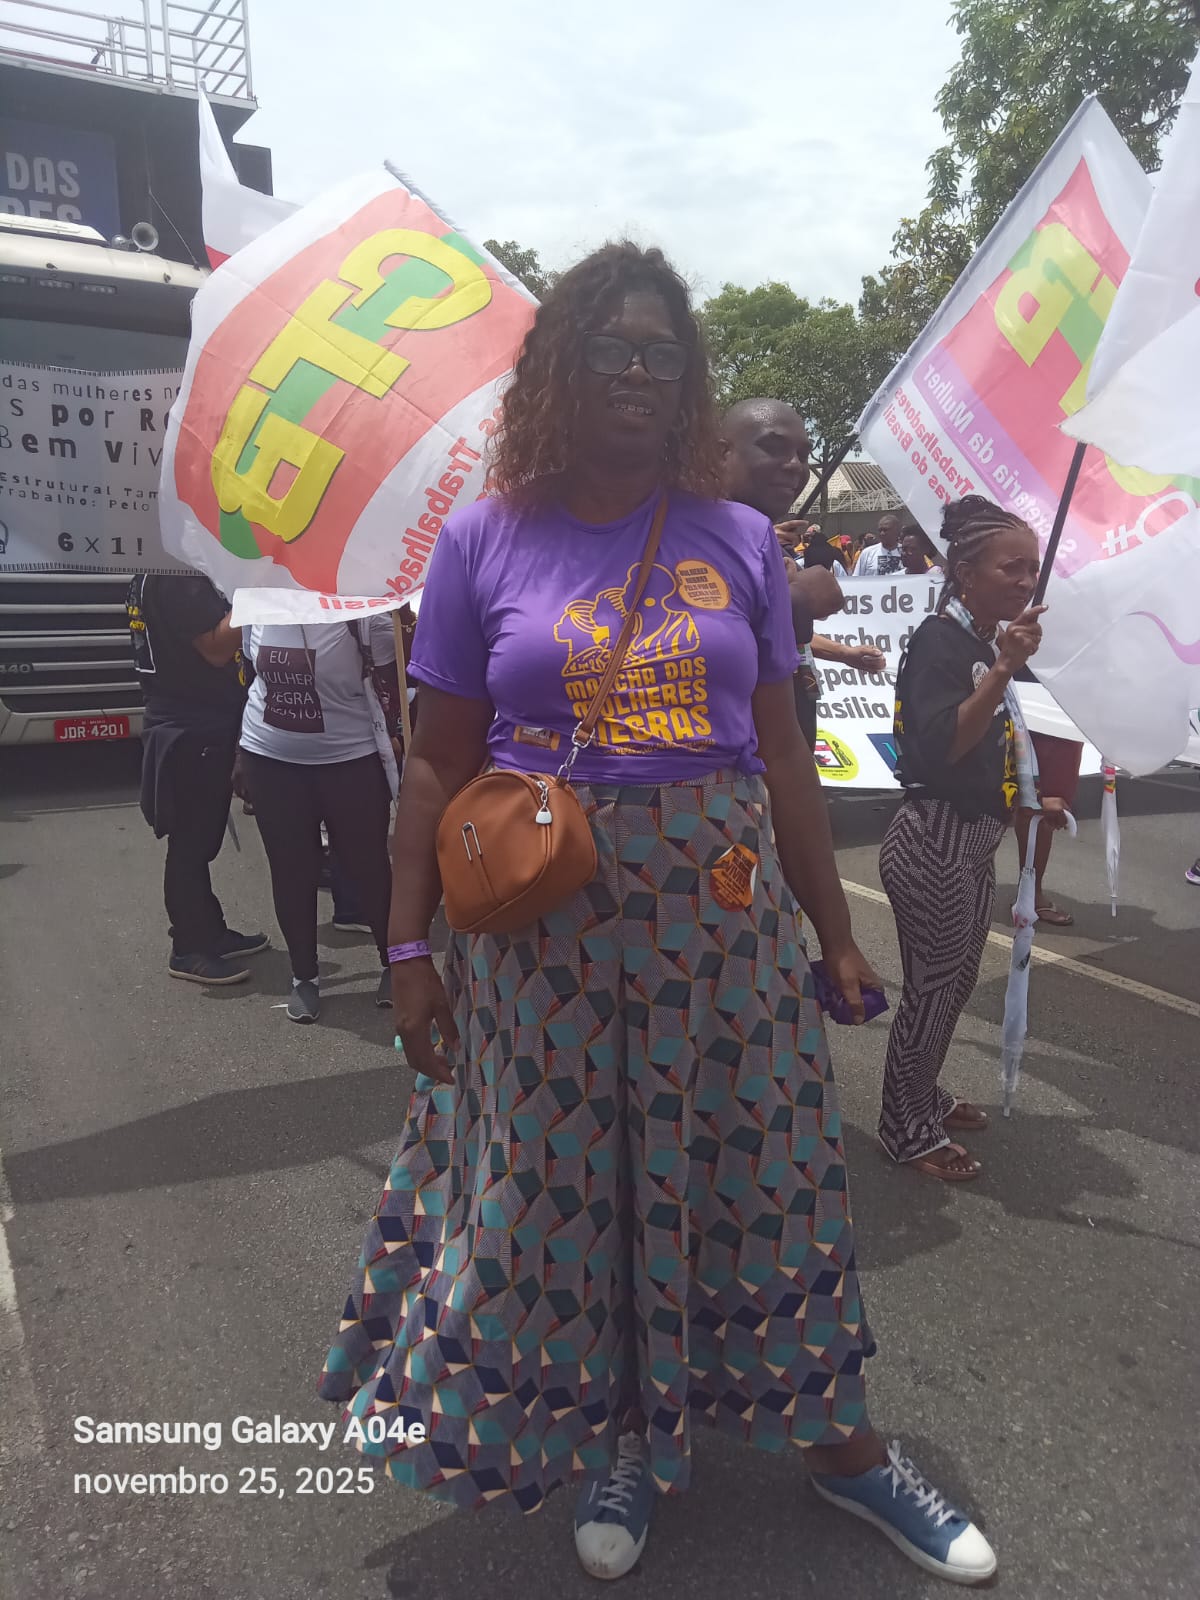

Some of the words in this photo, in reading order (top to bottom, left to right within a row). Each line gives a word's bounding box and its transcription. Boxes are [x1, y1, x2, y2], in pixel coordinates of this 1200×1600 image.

[6, 152, 81, 198] DAS
[3, 375, 40, 392] das
[53, 383, 152, 402] mulheres
[51, 404, 115, 428] por
[140, 408, 170, 432] R
[881, 586, 913, 613] de
[924, 587, 941, 613] J
[269, 650, 290, 667] EU,
[664, 656, 707, 681] DAS
[272, 691, 315, 706] EGRA
